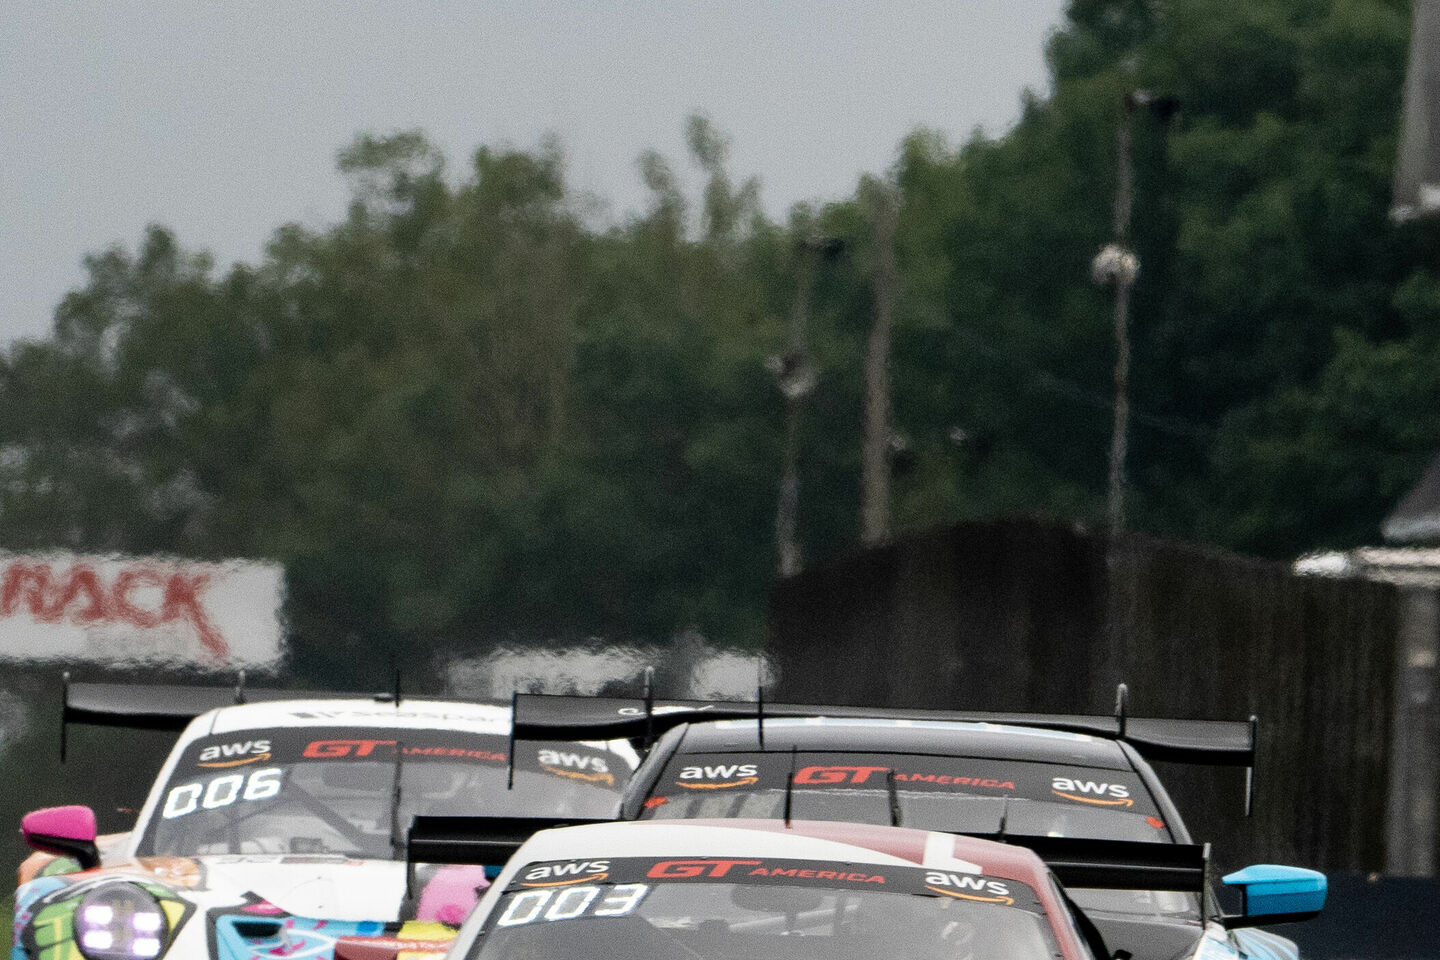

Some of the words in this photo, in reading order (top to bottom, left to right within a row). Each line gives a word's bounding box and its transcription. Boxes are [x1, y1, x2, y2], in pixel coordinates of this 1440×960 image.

[200, 740, 272, 761] aws
[302, 739, 397, 758] GT
[537, 748, 609, 774] aws
[162, 768, 282, 820] 006
[679, 763, 759, 782] aws
[793, 766, 895, 785] GT
[892, 772, 1016, 790] AMERICA
[1051, 777, 1130, 800] aws
[525, 859, 610, 882] aws
[646, 860, 759, 879] GT
[750, 866, 886, 884] AMERICA
[925, 871, 1010, 897] aws
[496, 884, 650, 928] 003
